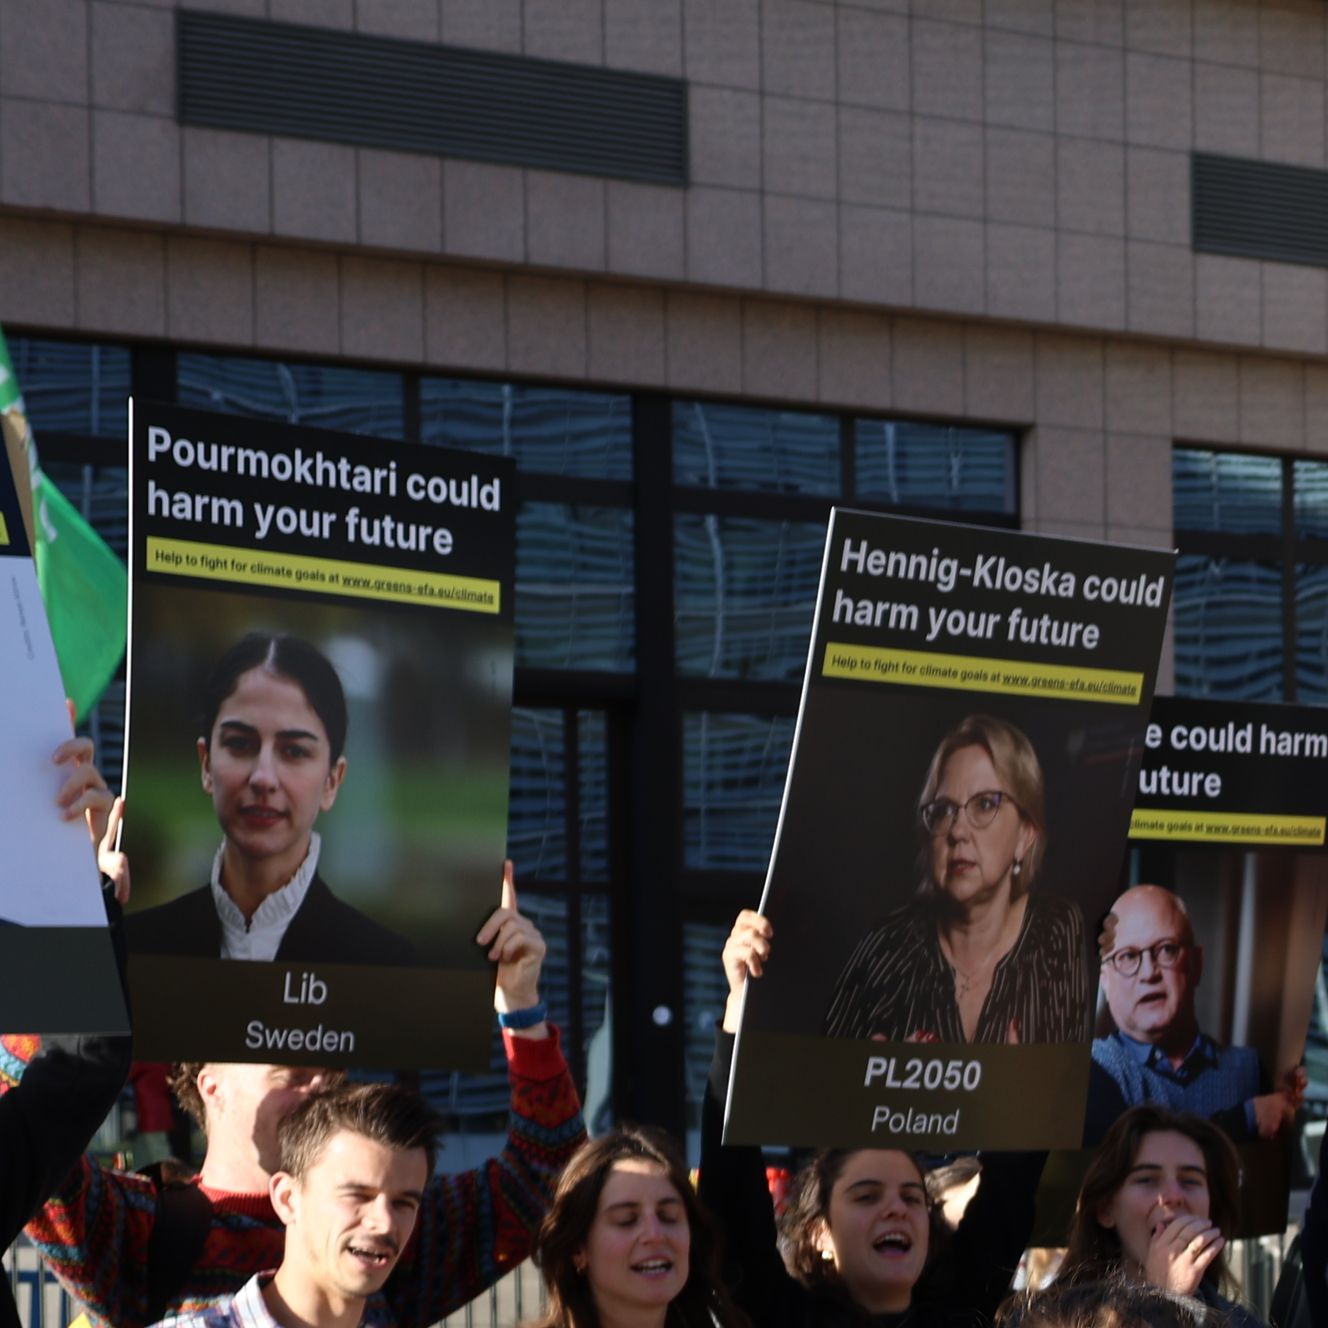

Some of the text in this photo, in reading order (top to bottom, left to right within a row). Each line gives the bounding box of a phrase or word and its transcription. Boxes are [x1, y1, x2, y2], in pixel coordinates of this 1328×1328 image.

[148, 426, 500, 512] Pourmokhtari could
[147, 480, 453, 555] harm your future
[840, 538, 1165, 608] Hennig-Kloska could
[832, 589, 1100, 649] harm your future
[283, 971, 328, 1005] Lib
[245, 1020, 355, 1052] Sweden
[864, 1056, 982, 1091] PL2050
[871, 1105, 960, 1135] Poland
